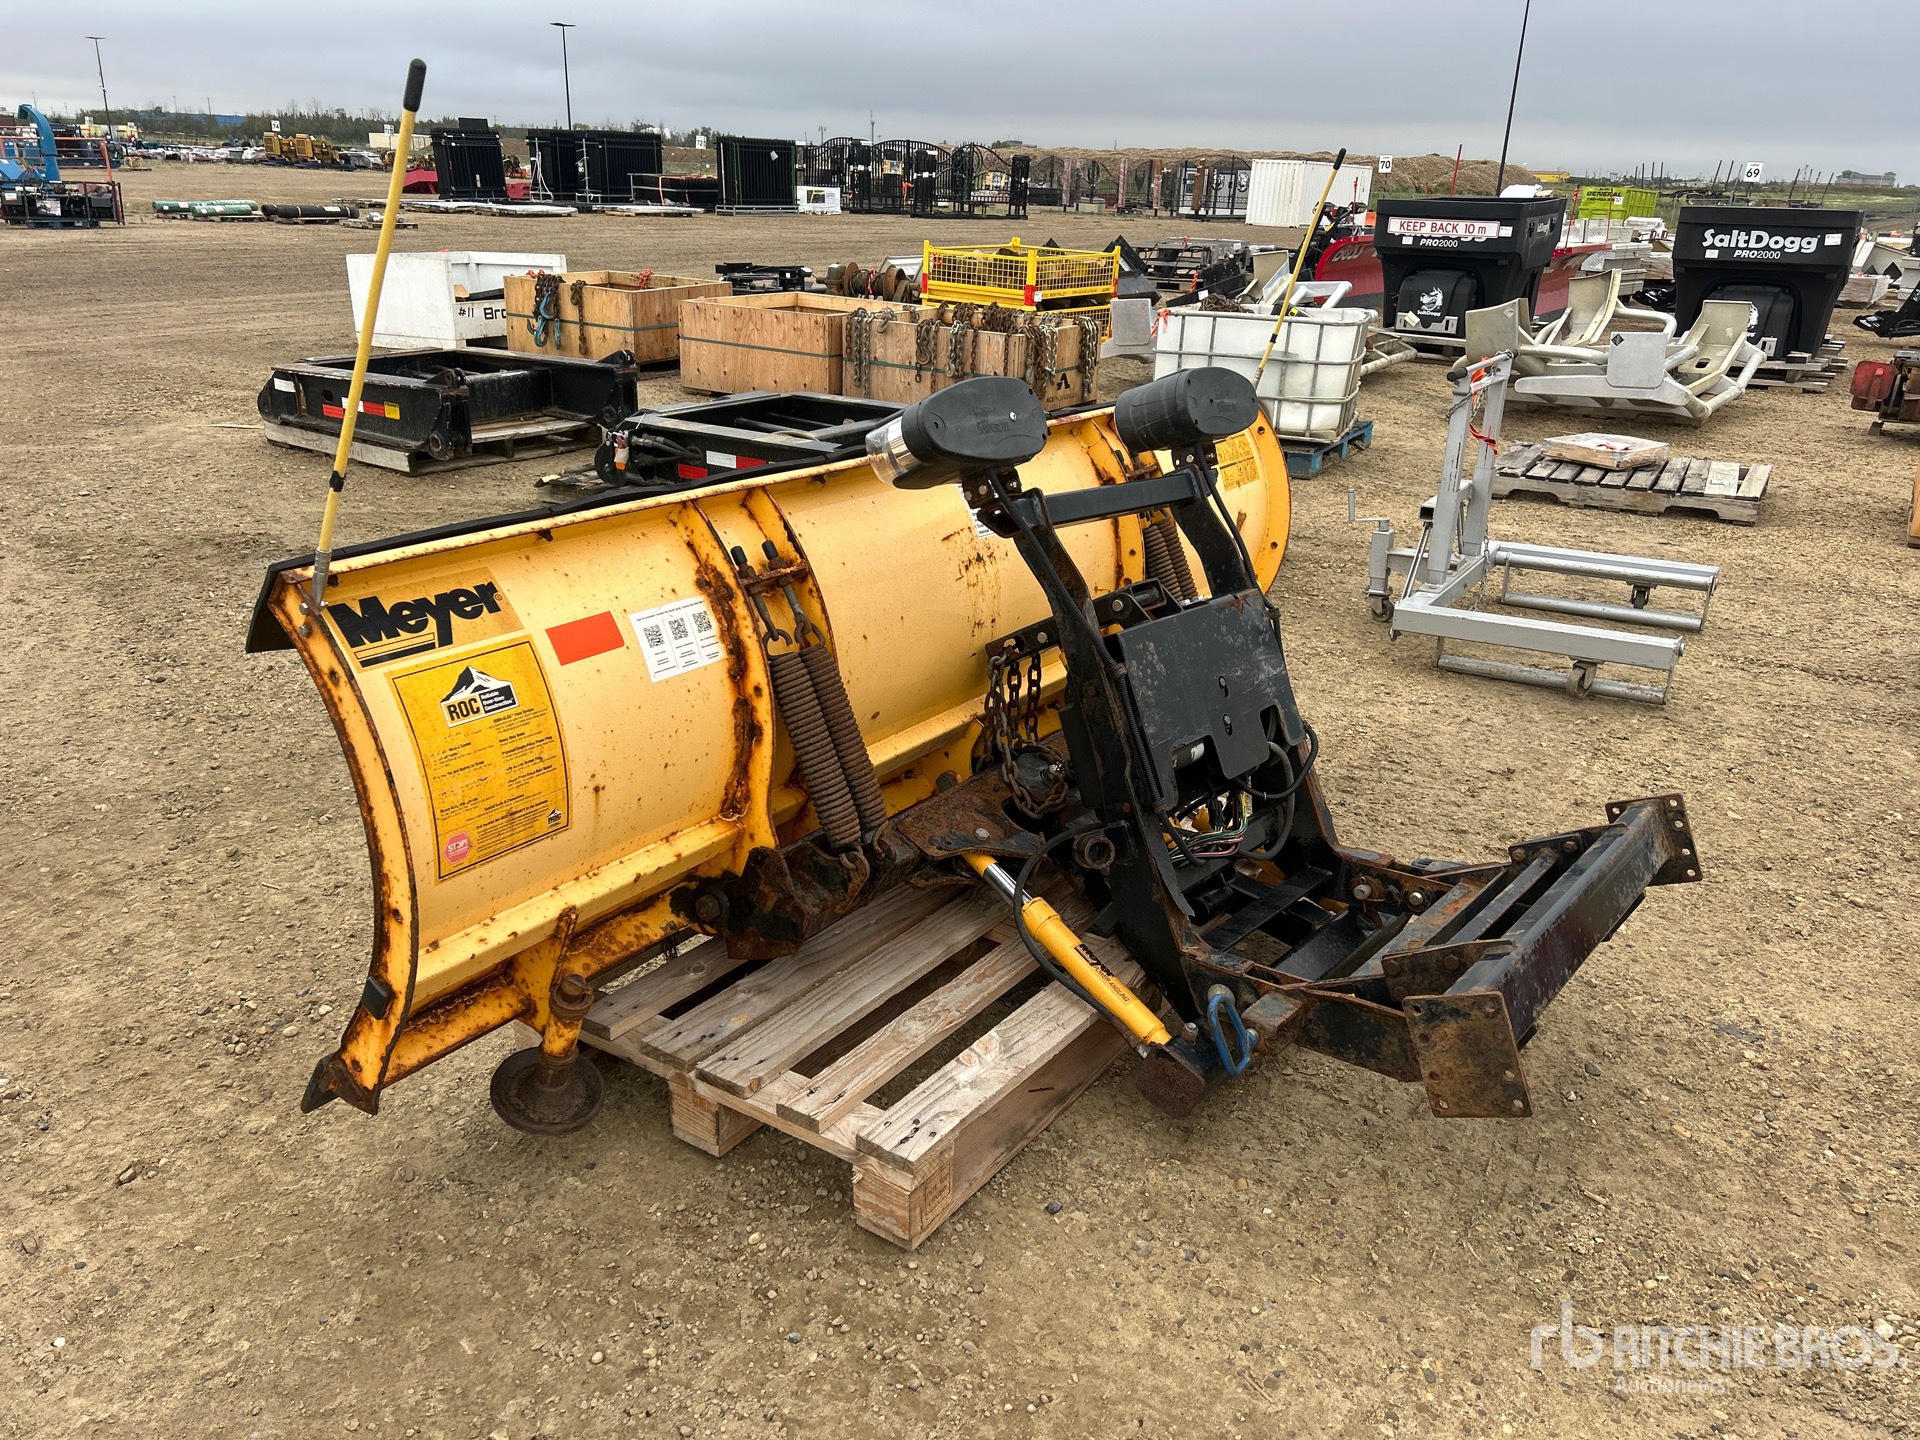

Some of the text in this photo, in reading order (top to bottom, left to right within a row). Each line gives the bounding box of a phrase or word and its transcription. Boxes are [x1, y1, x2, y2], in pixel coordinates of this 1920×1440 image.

[697, 139, 703, 147] 72
[1380, 160, 1391, 170] 70
[1746, 168, 1760, 178] 69
[1399, 220, 1427, 232] KEEP
[1430, 221, 1459, 234] BACK
[1464, 223, 1476, 235] 10
[1477, 226, 1487, 235] m
[1419, 238, 1459, 248] PRO2000
[1702, 228, 1819, 253] SaltDogg
[1733, 249, 1781, 260] PRO2000
[458, 306, 474, 318] #11
[327, 581, 502, 649] Meyer
[446, 697, 480, 722] ROC
[1093, 965, 1111, 983] POWER
[1108, 982, 1130, 1002] ANGLING
